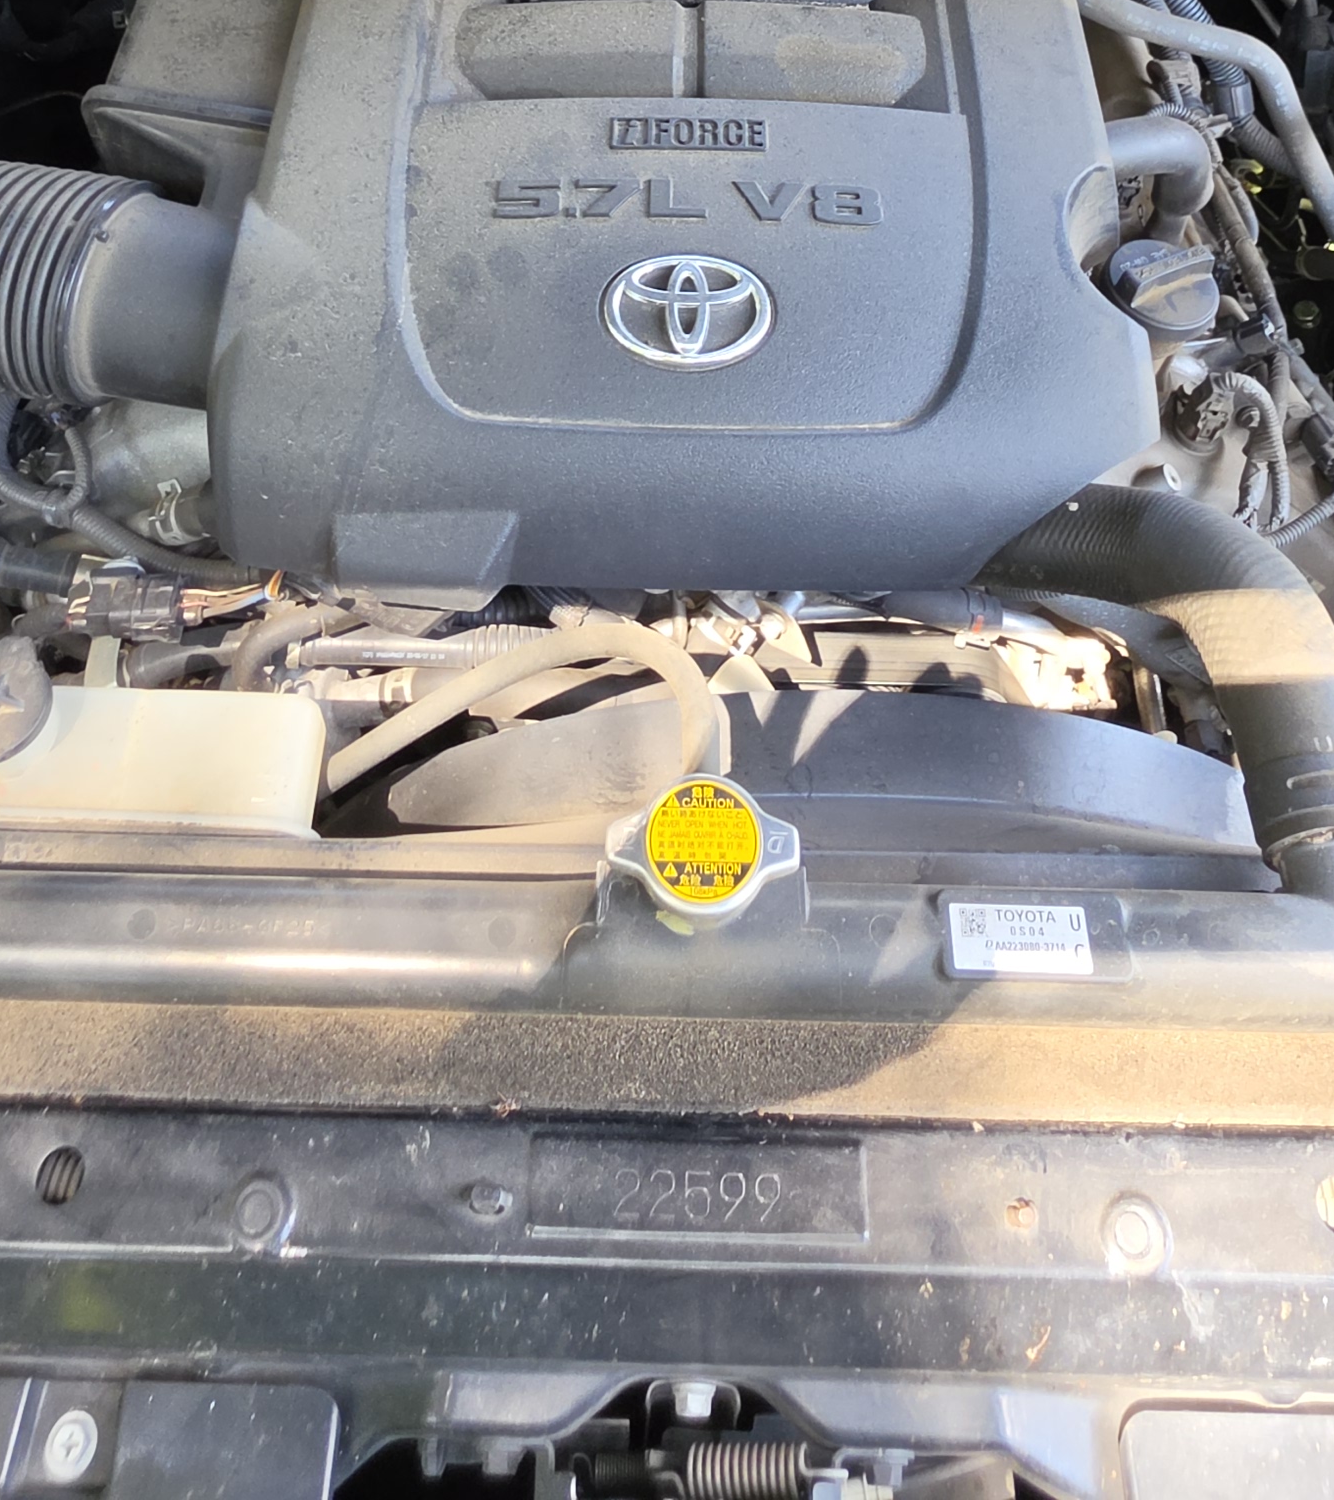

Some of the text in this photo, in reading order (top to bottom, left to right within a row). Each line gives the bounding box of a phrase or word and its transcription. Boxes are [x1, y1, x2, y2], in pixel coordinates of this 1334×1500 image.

[654, 118, 764, 148] FORCE
[492, 178, 884, 226] 5.7L V8
[681, 798, 735, 809] CAUTION
[685, 820, 704, 829] OPEN
[684, 862, 742, 875] ATTENTION
[994, 909, 1056, 924] TOYOTA
[1069, 913, 1082, 932] U
[612, 1168, 782, 1223] 22599
